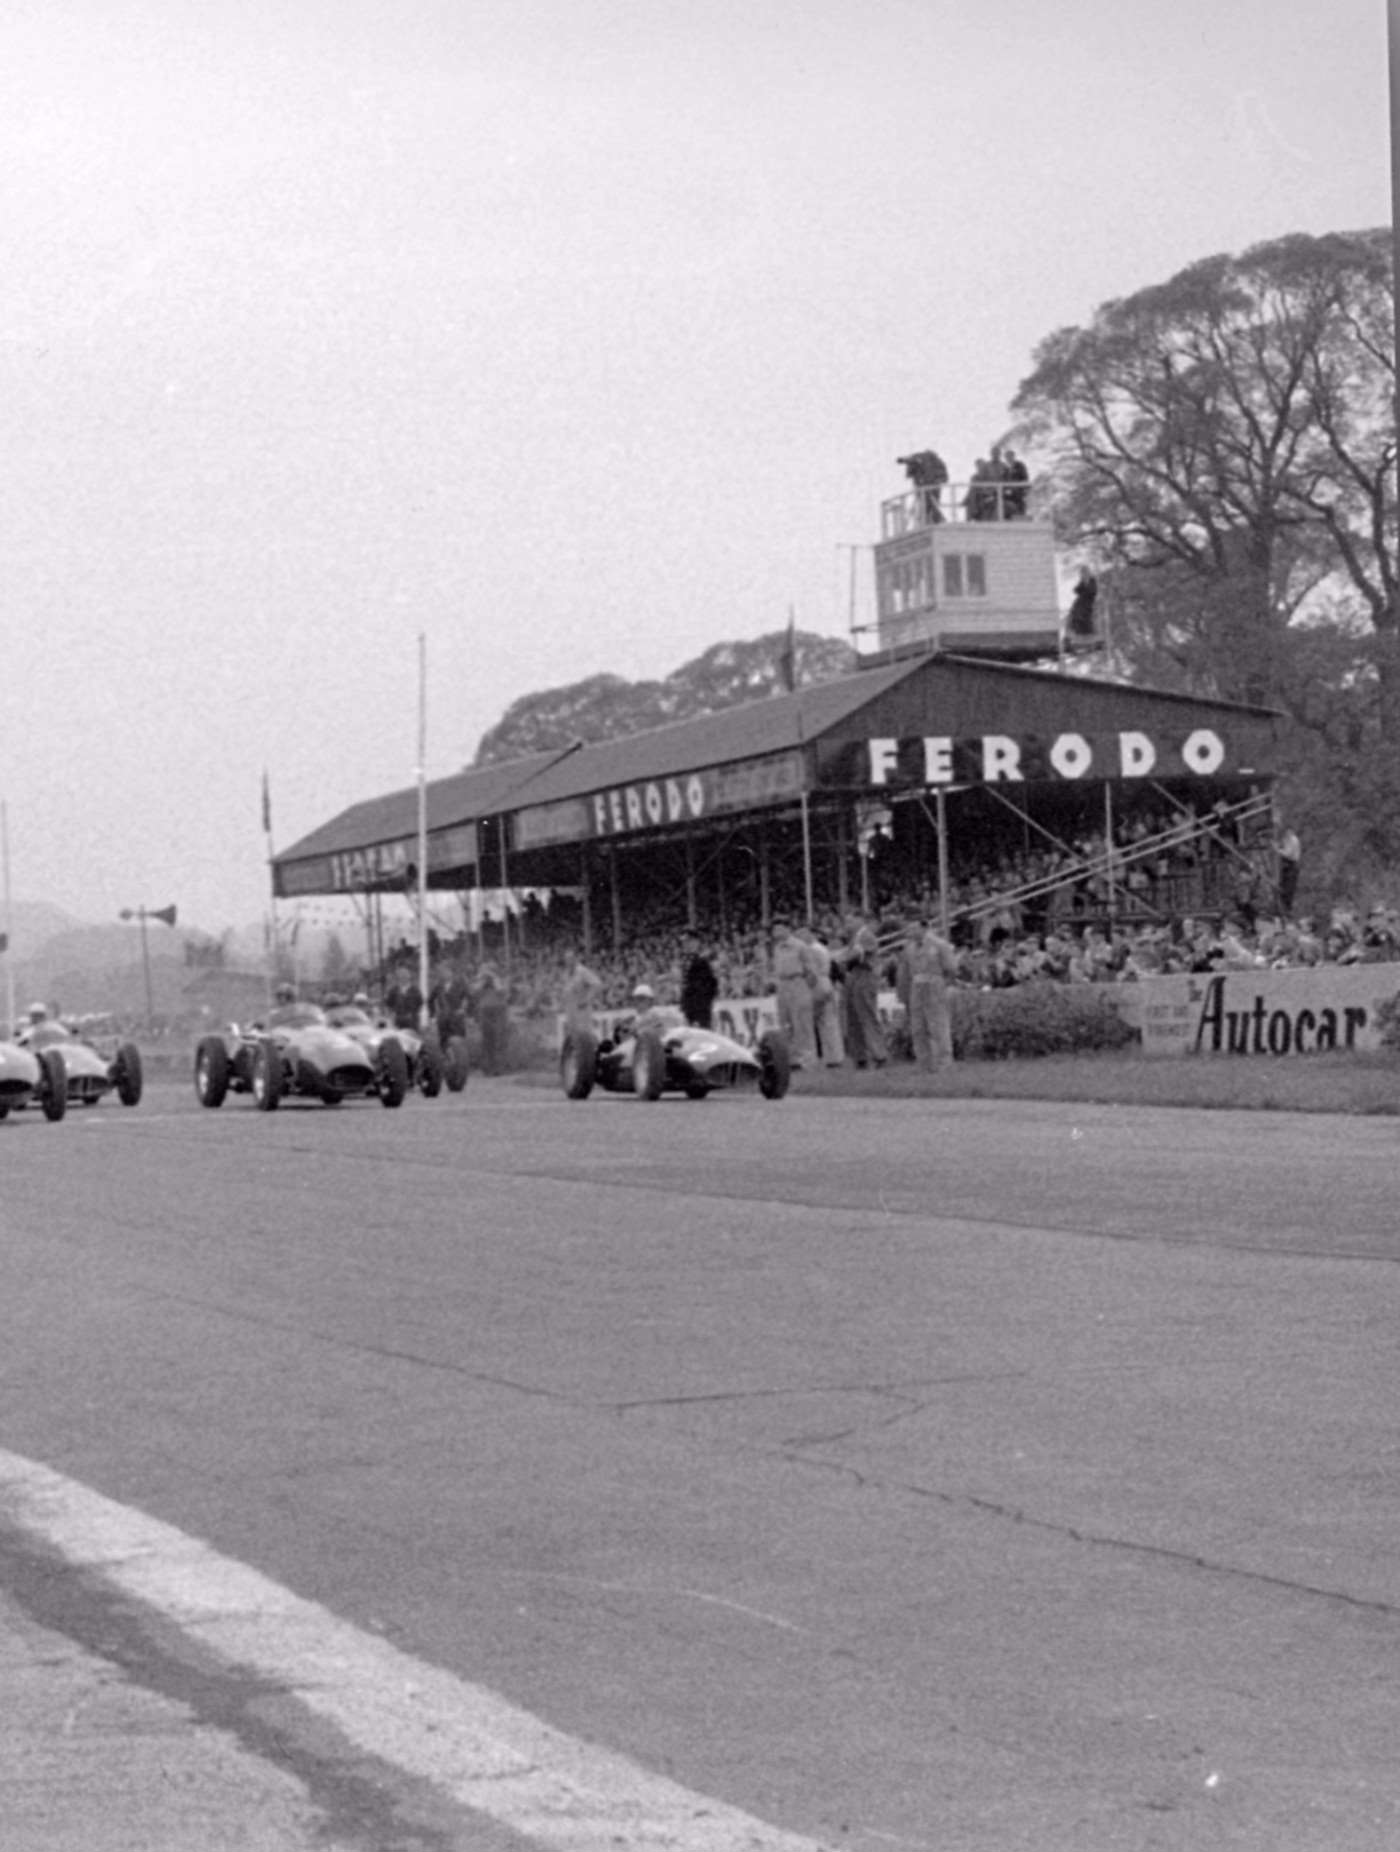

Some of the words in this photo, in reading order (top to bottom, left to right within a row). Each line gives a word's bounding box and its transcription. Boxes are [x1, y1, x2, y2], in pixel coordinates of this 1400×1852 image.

[868, 729, 1225, 784] FERODO
[594, 774, 703, 836] FERODO
[1192, 976, 1367, 1056] Autocar
